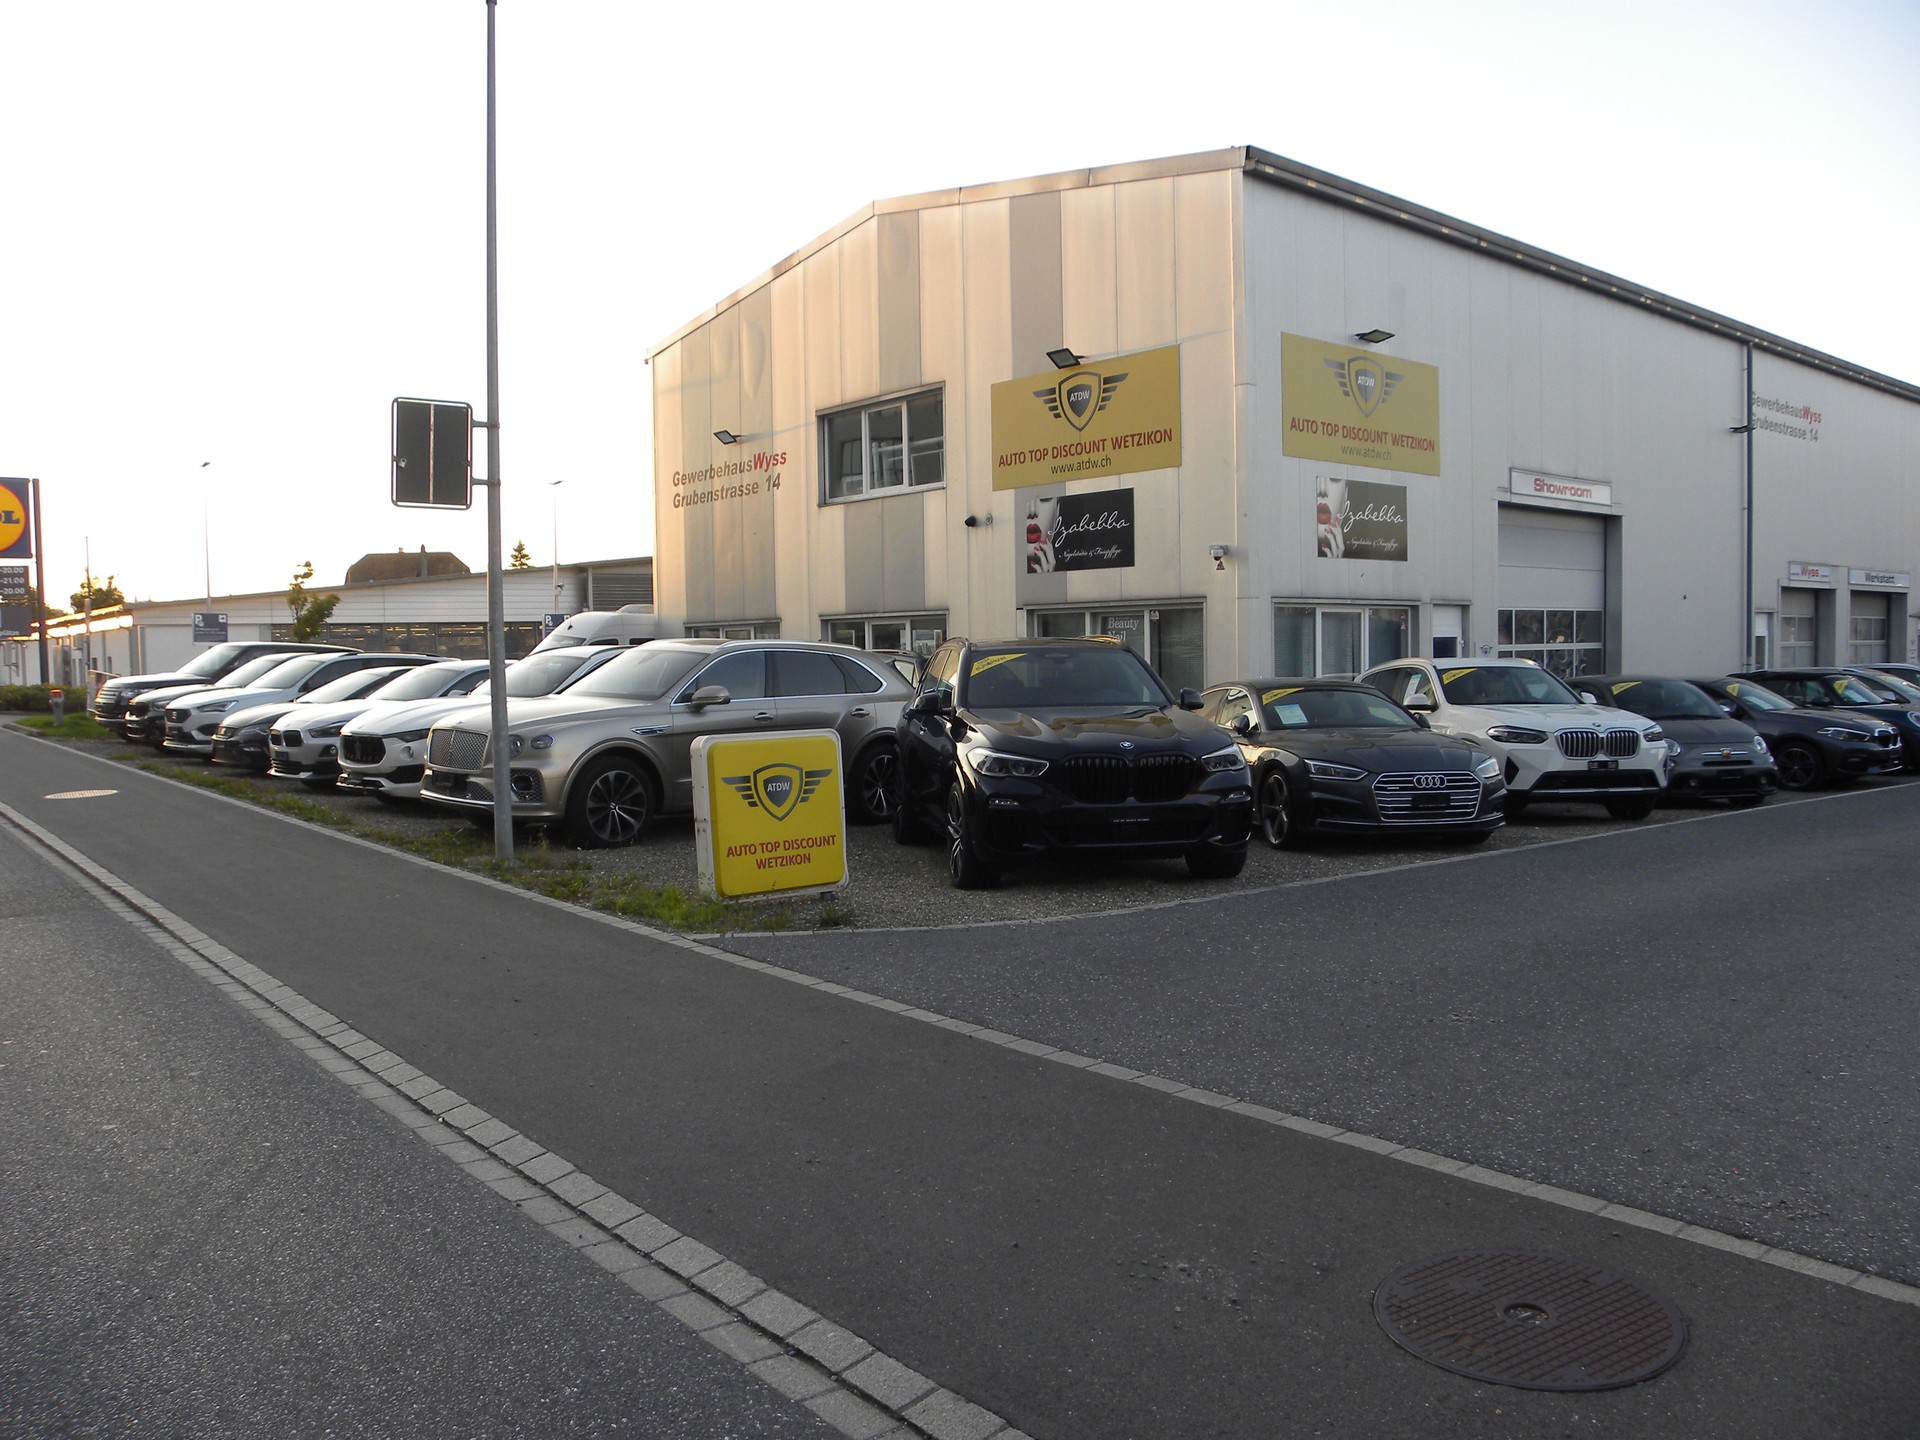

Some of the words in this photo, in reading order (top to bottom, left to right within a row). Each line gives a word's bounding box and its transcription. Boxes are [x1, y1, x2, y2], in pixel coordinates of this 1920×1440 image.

[1069, 390, 1090, 402] ATDW
[1290, 417, 1318, 434] AUTO
[1320, 421, 1340, 437] TOP
[1342, 425, 1388, 445] DISCOUNT
[1391, 432, 1435, 452] WETZIKON
[998, 451, 1026, 467] AUTO
[1028, 447, 1048, 463] TOP
[1051, 438, 1107, 460] DISCOUNT
[1110, 428, 1173, 450] WETZIKON
[1341, 445, 1392, 460] www.atdw.ch
[672, 451, 787, 487] GewerbehausWyss
[1050, 455, 1112, 475] www.atdw.ch
[673, 481, 759, 508] Grubenstrasse
[765, 472, 781, 492] 14
[1533, 478, 1592, 499] Showroom
[0, 510, 20, 524] L
[1108, 617, 1139, 630] Beauty
[766, 782, 790, 792] ATDW
[726, 844, 757, 858] AUTO
[759, 842, 780, 853] TOP
[783, 834, 837, 851] DISCOUNT
[755, 853, 811, 870] WETZIKON
